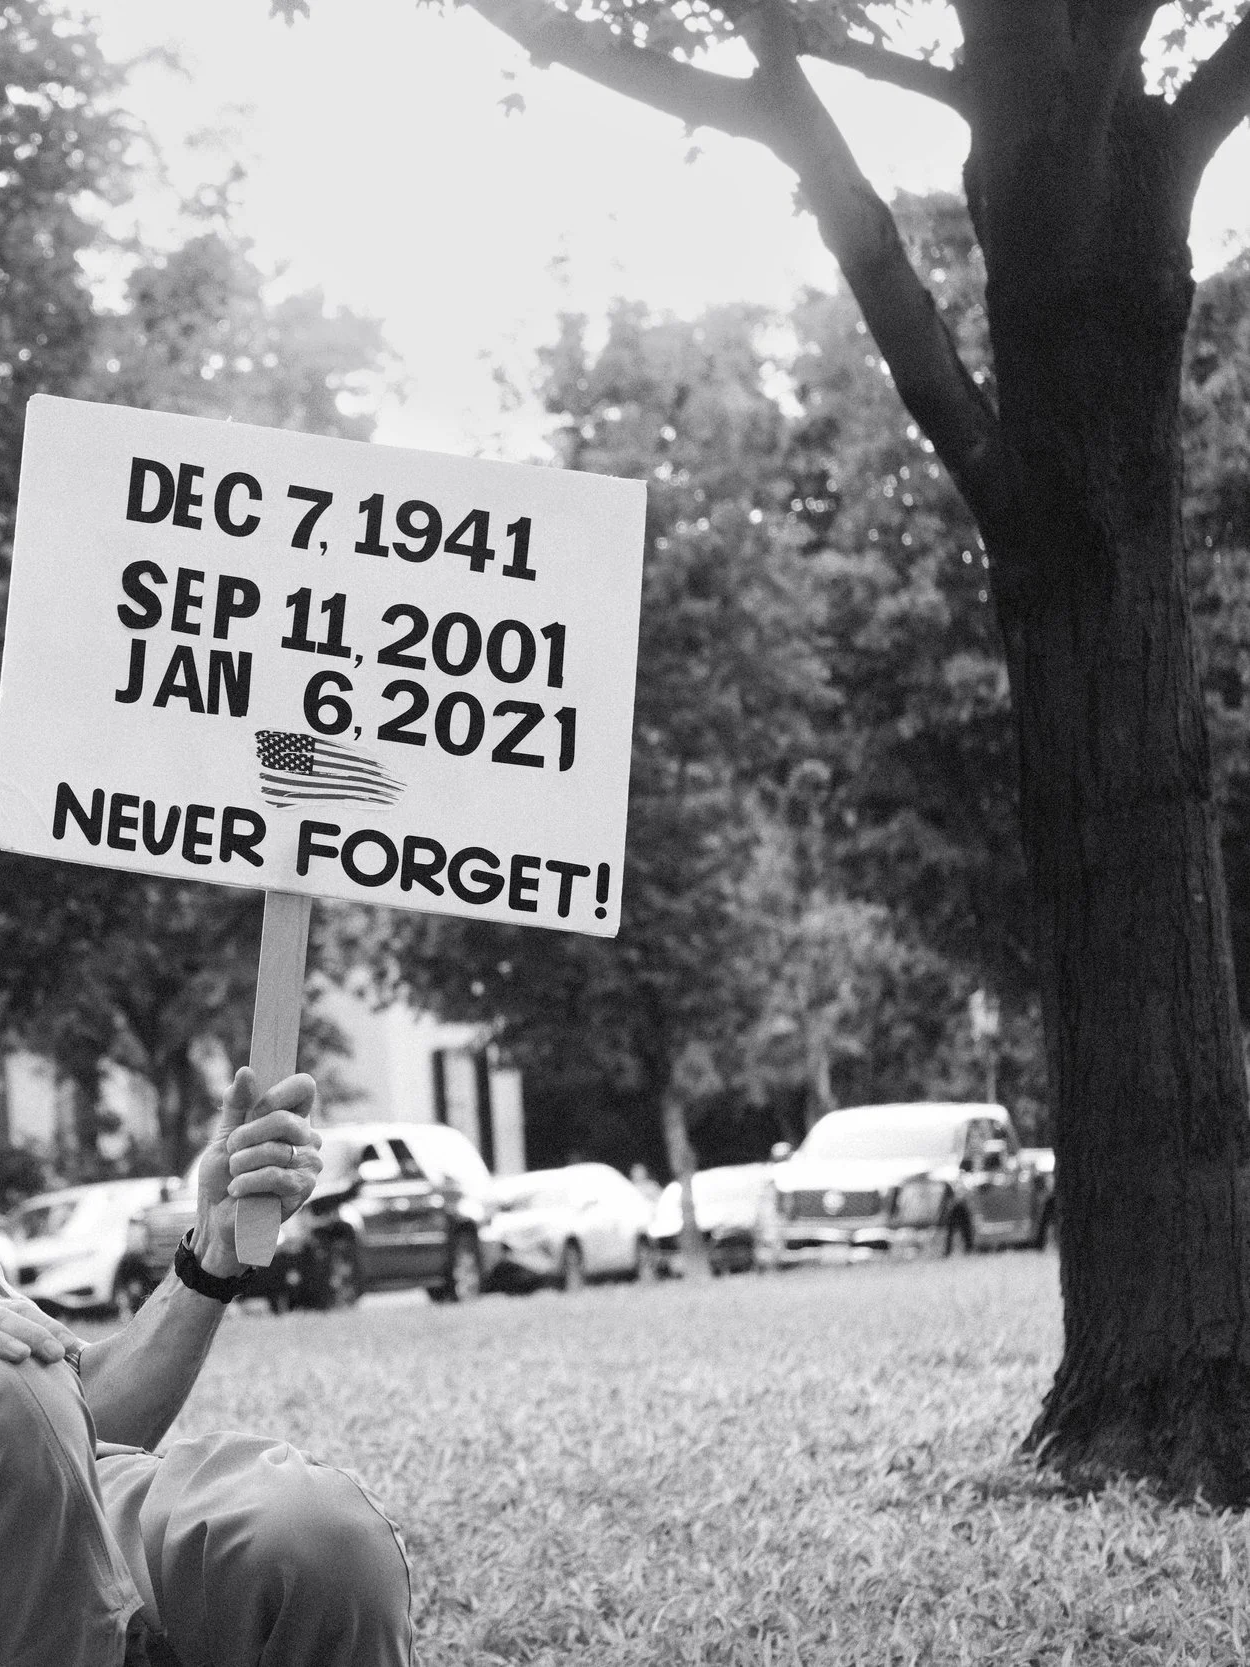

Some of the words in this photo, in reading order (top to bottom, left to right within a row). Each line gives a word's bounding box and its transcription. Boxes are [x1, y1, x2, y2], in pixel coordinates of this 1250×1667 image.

[126, 456, 263, 538] DEC
[286, 484, 334, 556] 7,
[354, 493, 537, 582] 1941
[117, 560, 261, 640] SEP
[281, 587, 364, 669] 11,
[377, 603, 566, 689] 2001
[114, 638, 253, 718] JAN
[303, 670, 363, 741] 6,
[377, 679, 577, 772] 2021
[52, 781, 267, 868] NEVER
[296, 819, 611, 920] FORGET!
